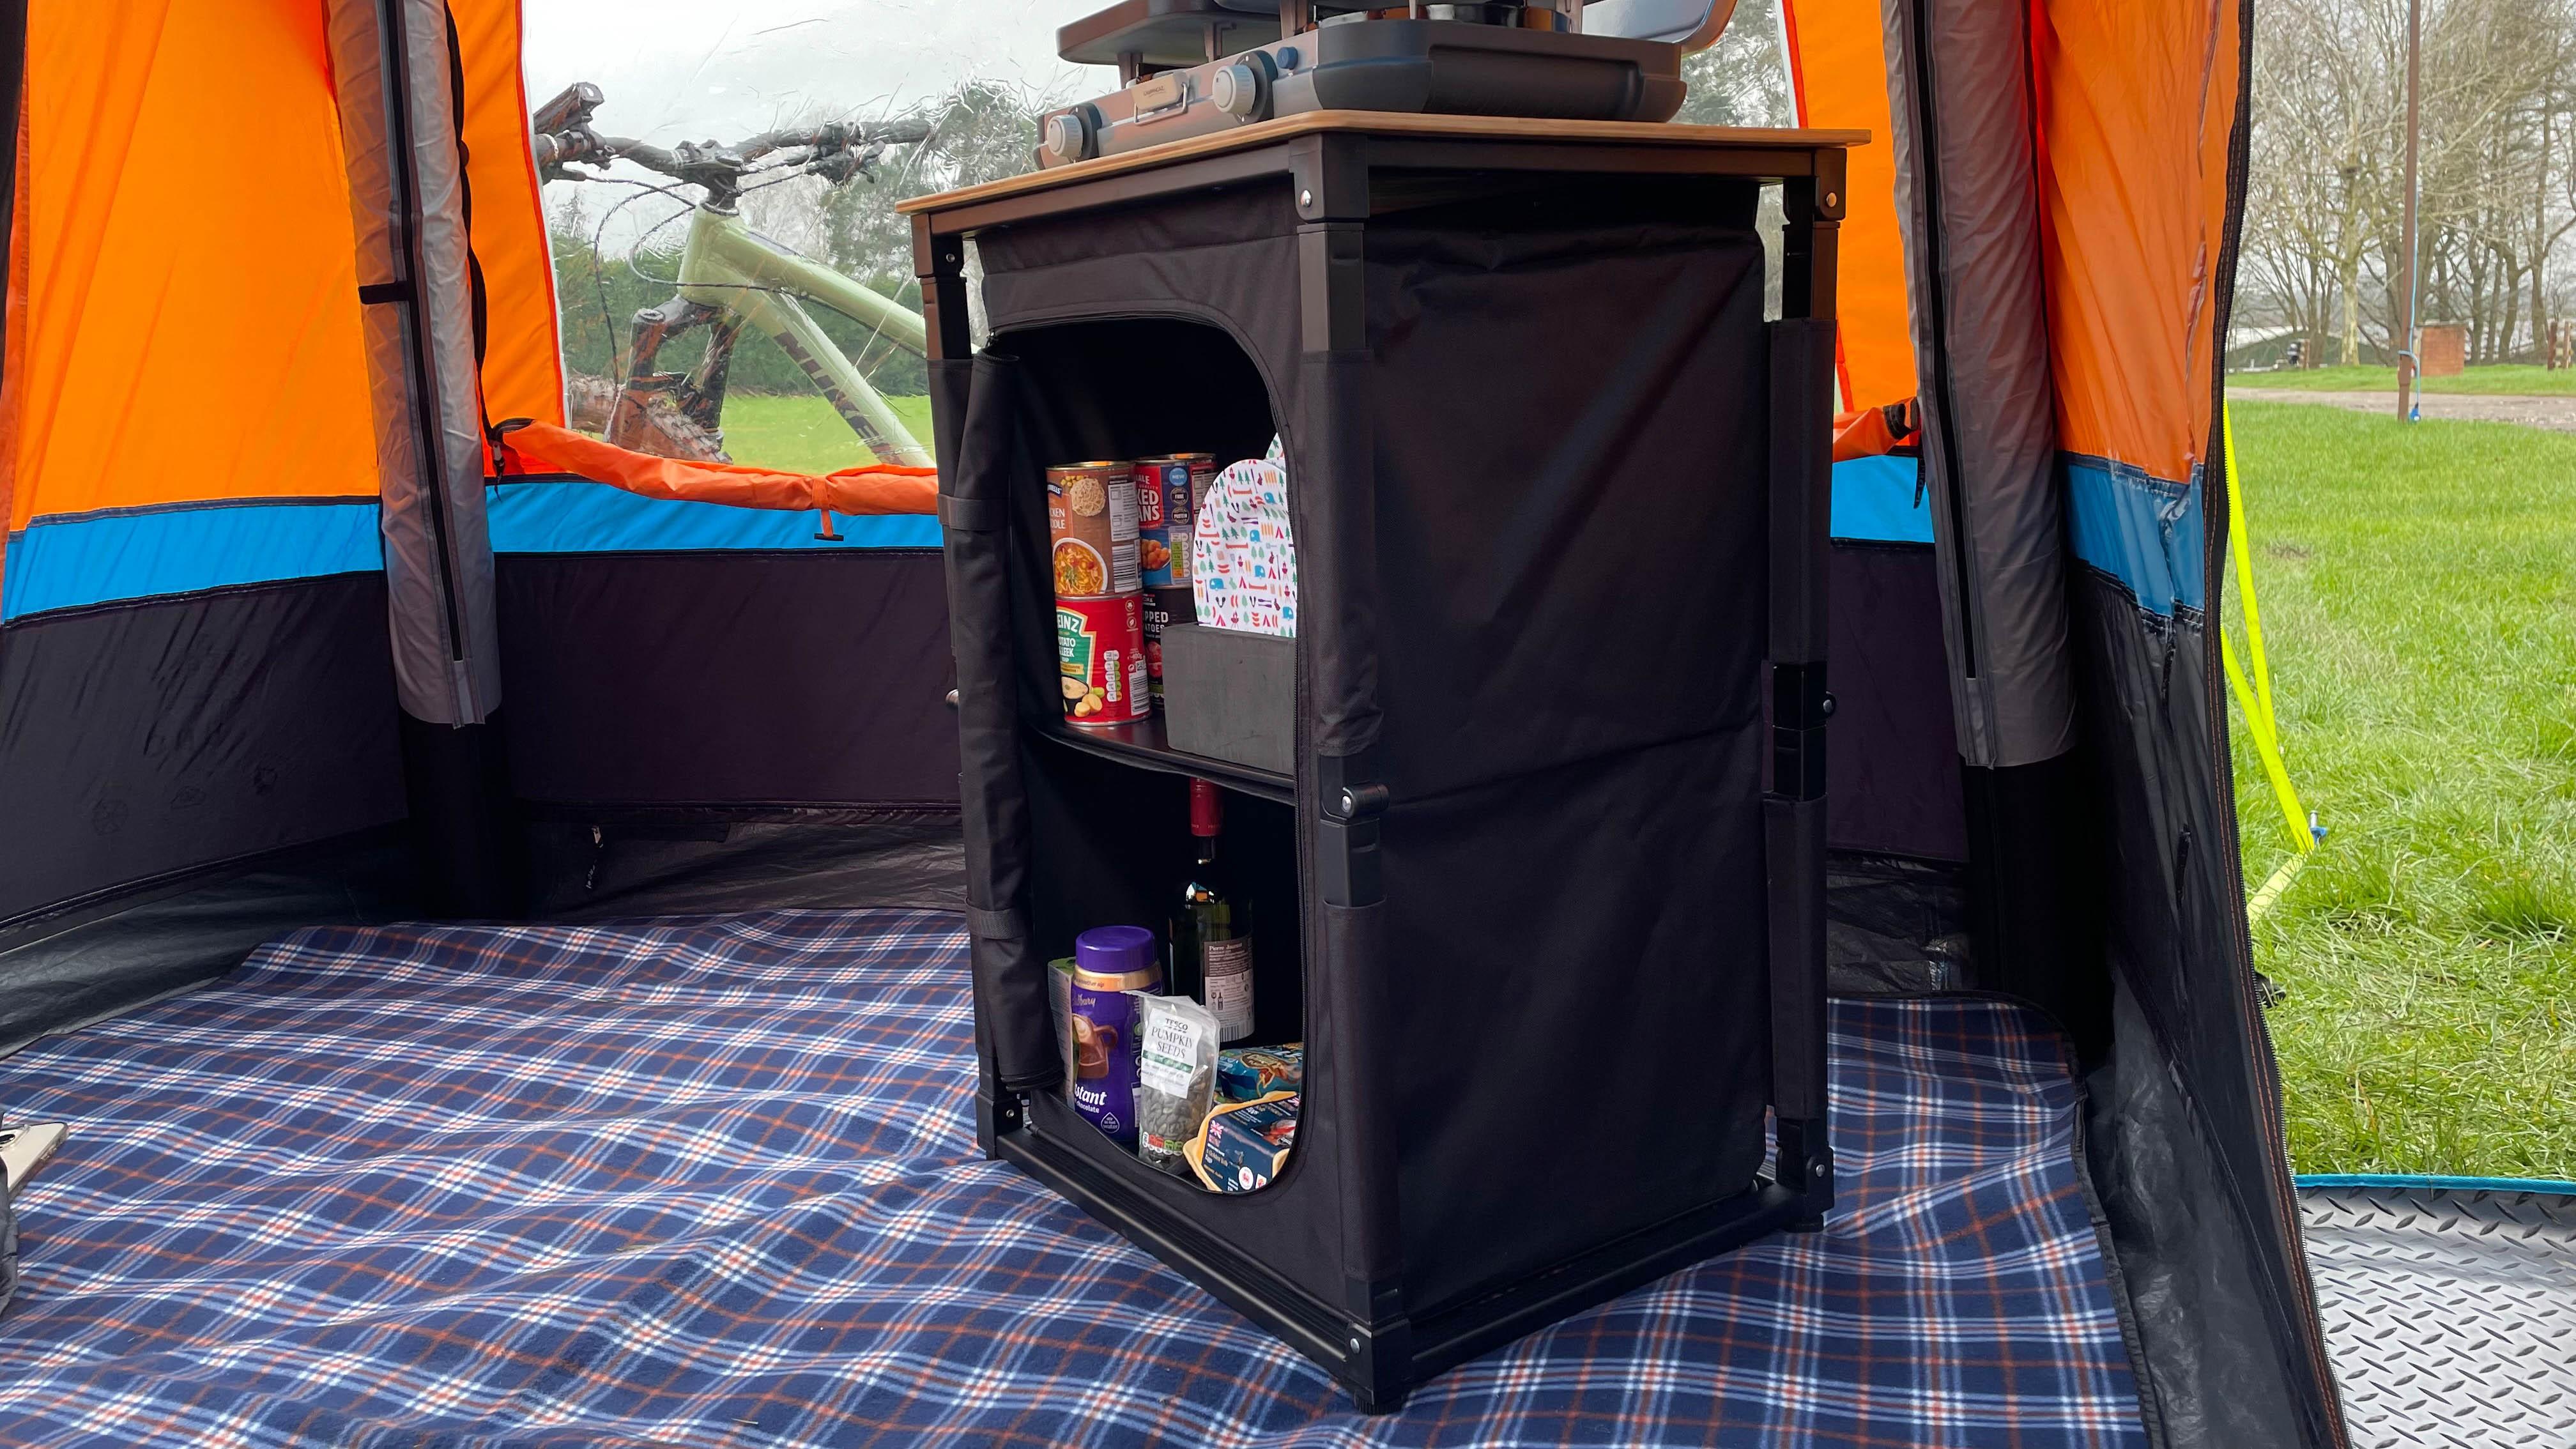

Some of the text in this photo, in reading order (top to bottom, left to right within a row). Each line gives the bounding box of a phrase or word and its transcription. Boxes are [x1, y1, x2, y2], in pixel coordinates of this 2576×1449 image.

[1144, 610, 1169, 624] PPED
[1165, 1018, 1188, 1031] TESCO
[1157, 1041, 1186, 1059] SEEDS
[1075, 1084, 1107, 1106] stant
